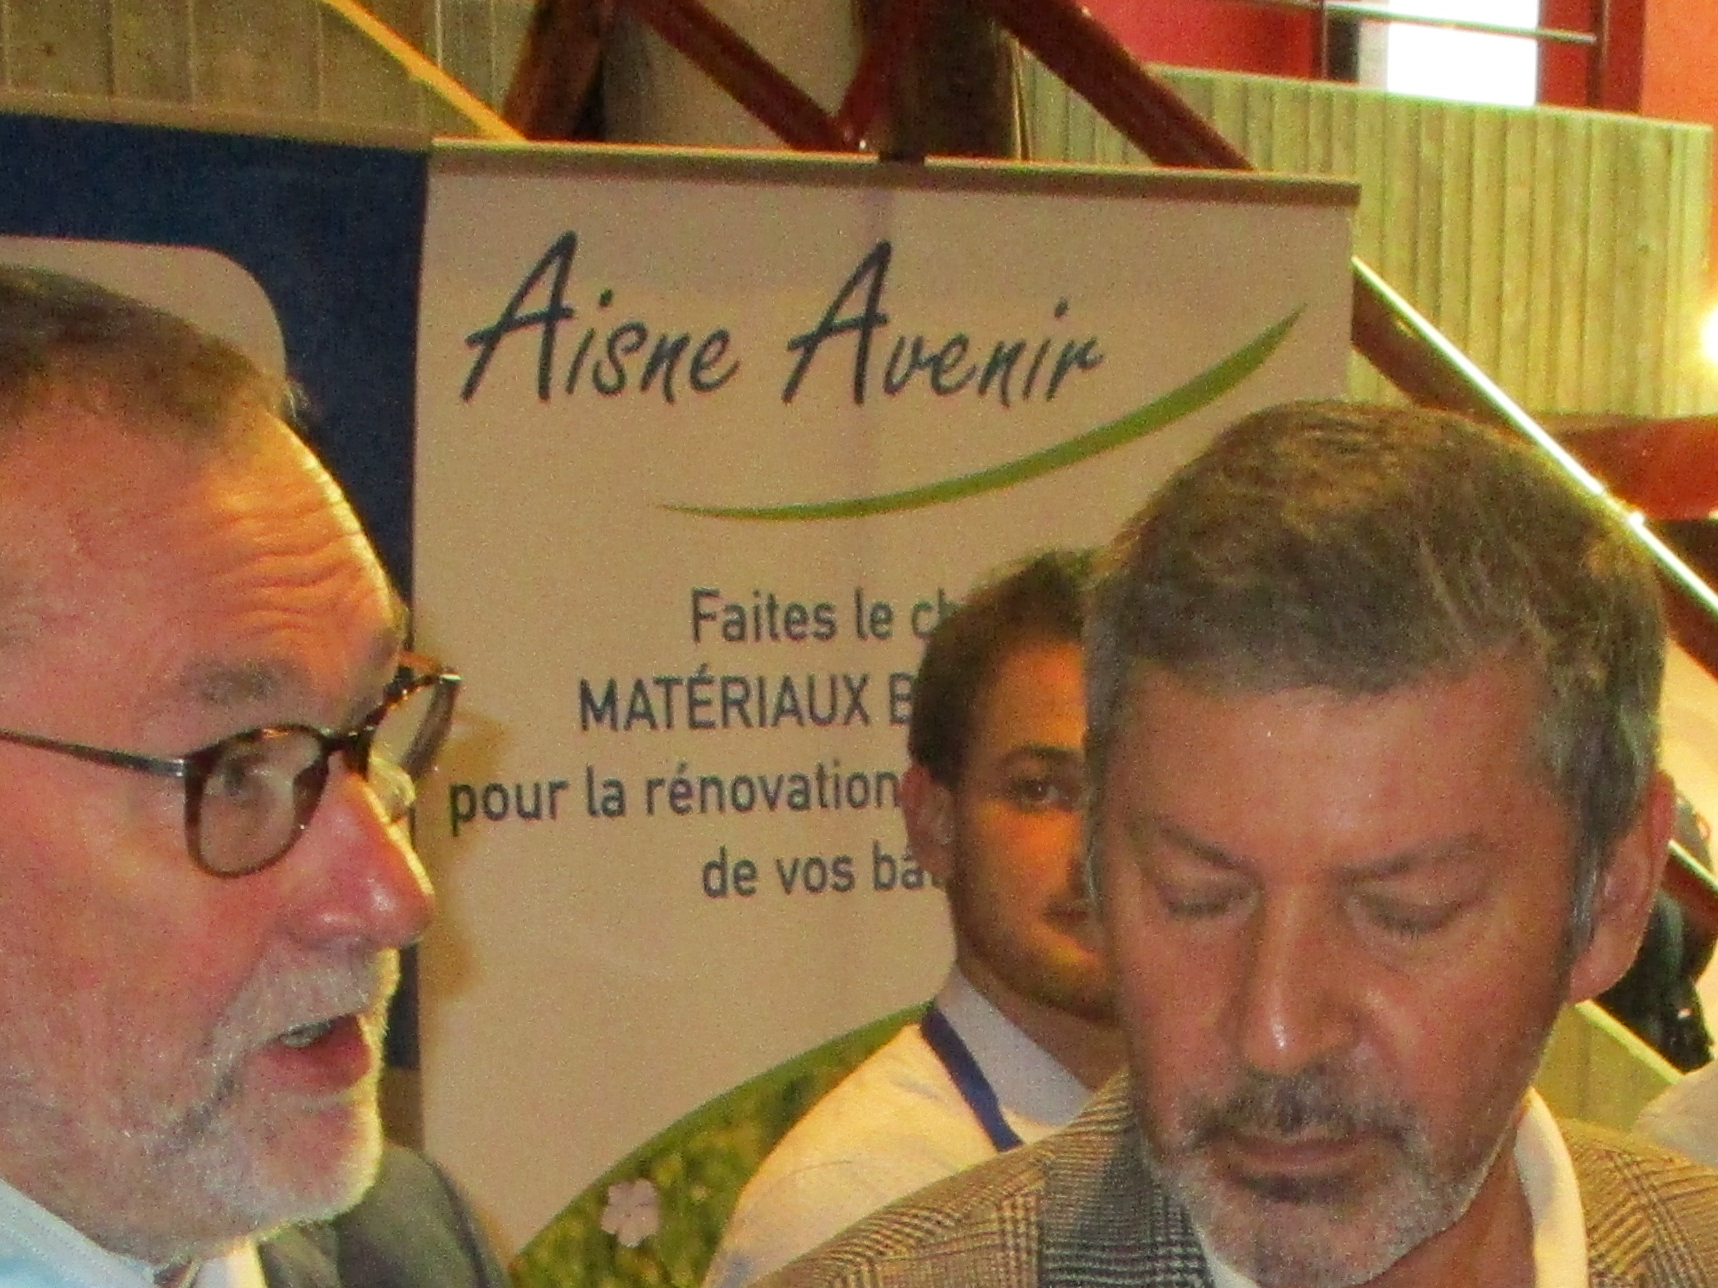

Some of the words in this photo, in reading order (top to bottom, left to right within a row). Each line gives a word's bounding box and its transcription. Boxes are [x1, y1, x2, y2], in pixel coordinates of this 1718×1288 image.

[460, 230, 741, 404] Aisne
[782, 239, 1104, 407] Avenir
[691, 588, 838, 644] Faites
[855, 586, 895, 641] le
[579, 663, 870, 732] MATÉRIAUX
[449, 779, 569, 837] pour
[586, 764, 626, 818] la
[646, 759, 902, 818] rénovation
[702, 845, 758, 898] de
[776, 853, 856, 896] vos
